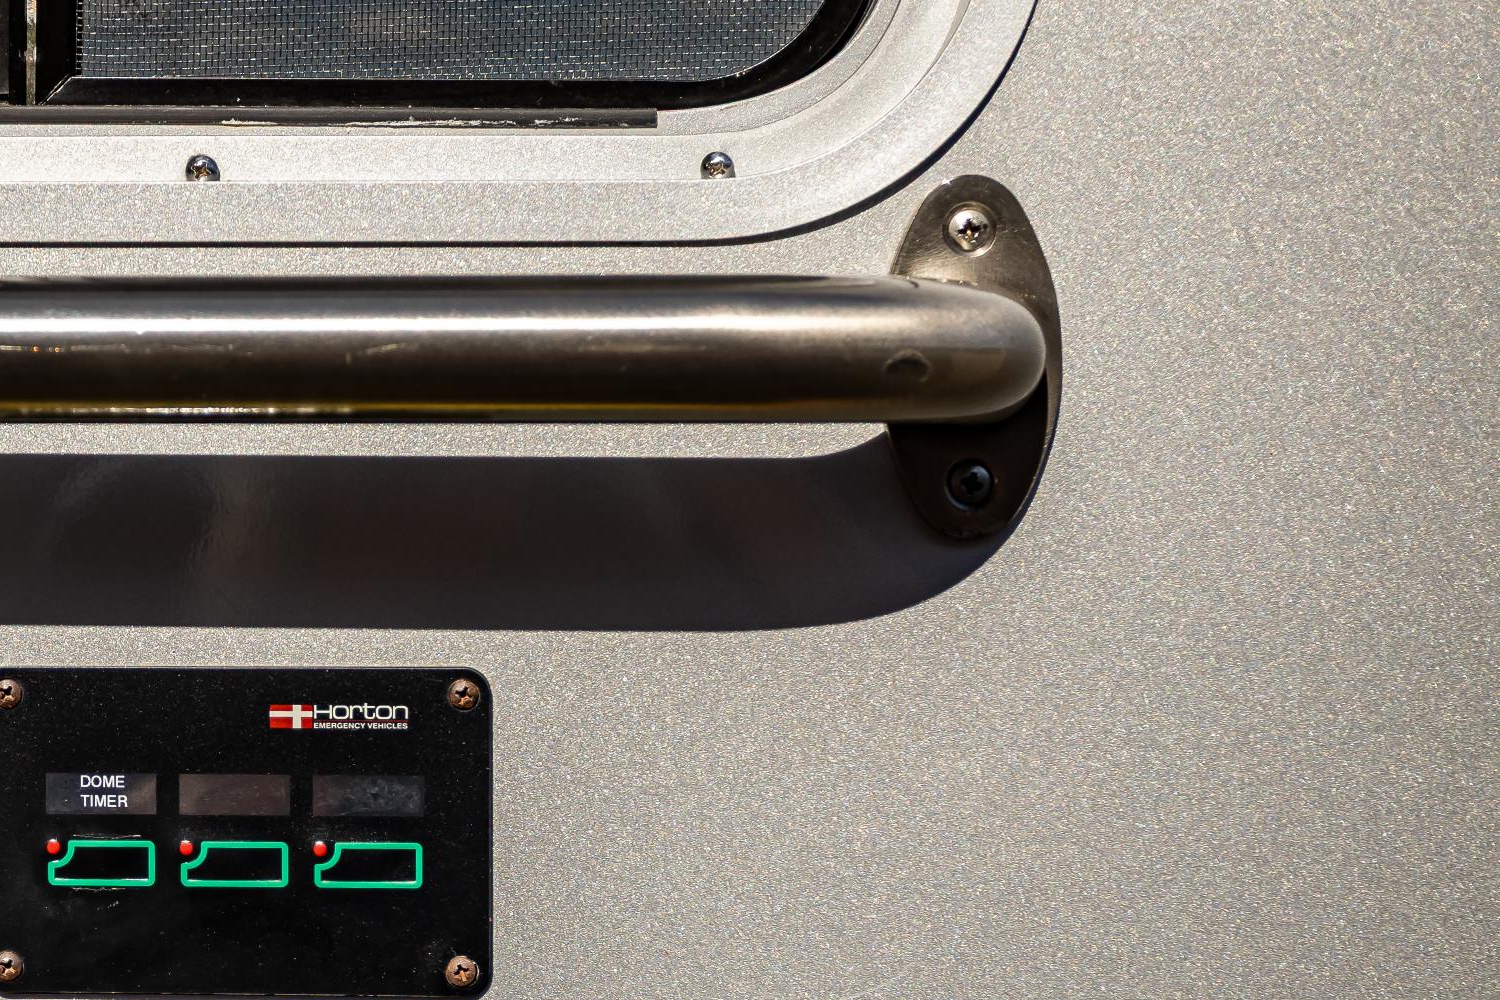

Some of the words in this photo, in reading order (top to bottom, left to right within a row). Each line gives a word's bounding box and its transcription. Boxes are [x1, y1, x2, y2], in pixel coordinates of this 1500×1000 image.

[313, 702, 409, 720] Horton
[313, 722, 365, 730] EMERGENCY
[367, 722, 409, 730] VEHICLES
[80, 775, 125, 788] DOME
[80, 794, 128, 808] TIMER
